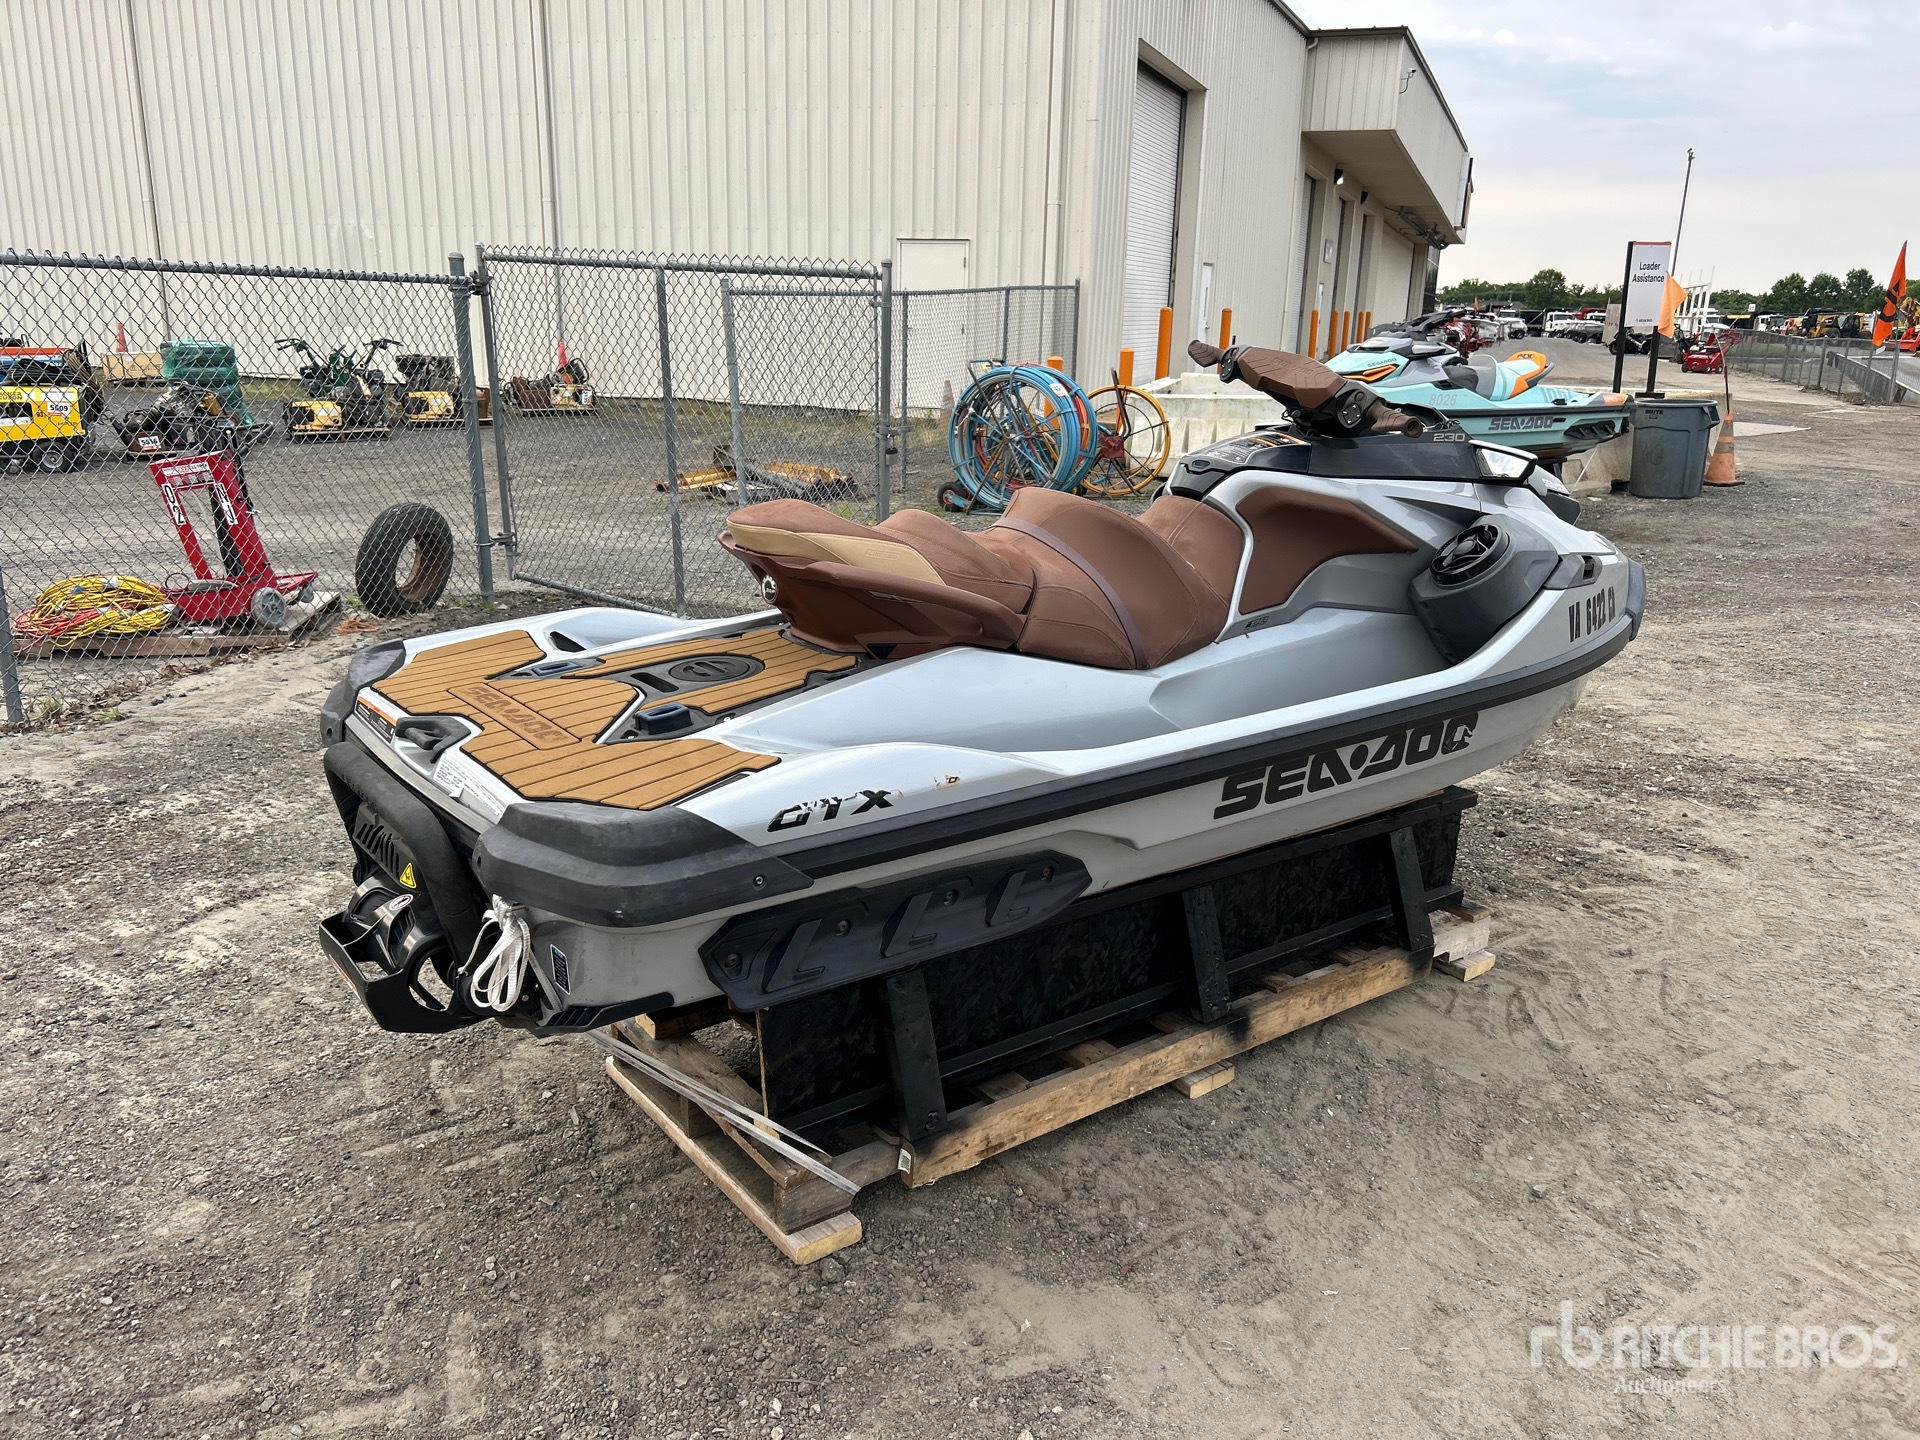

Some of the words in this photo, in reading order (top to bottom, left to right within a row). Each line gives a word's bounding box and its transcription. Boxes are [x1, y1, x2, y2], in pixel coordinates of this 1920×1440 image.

[1639, 261, 1660, 270] Loader
[1632, 273, 1665, 283] Assistance
[1429, 394, 1457, 406] 8026
[1433, 433, 1466, 442] 230
